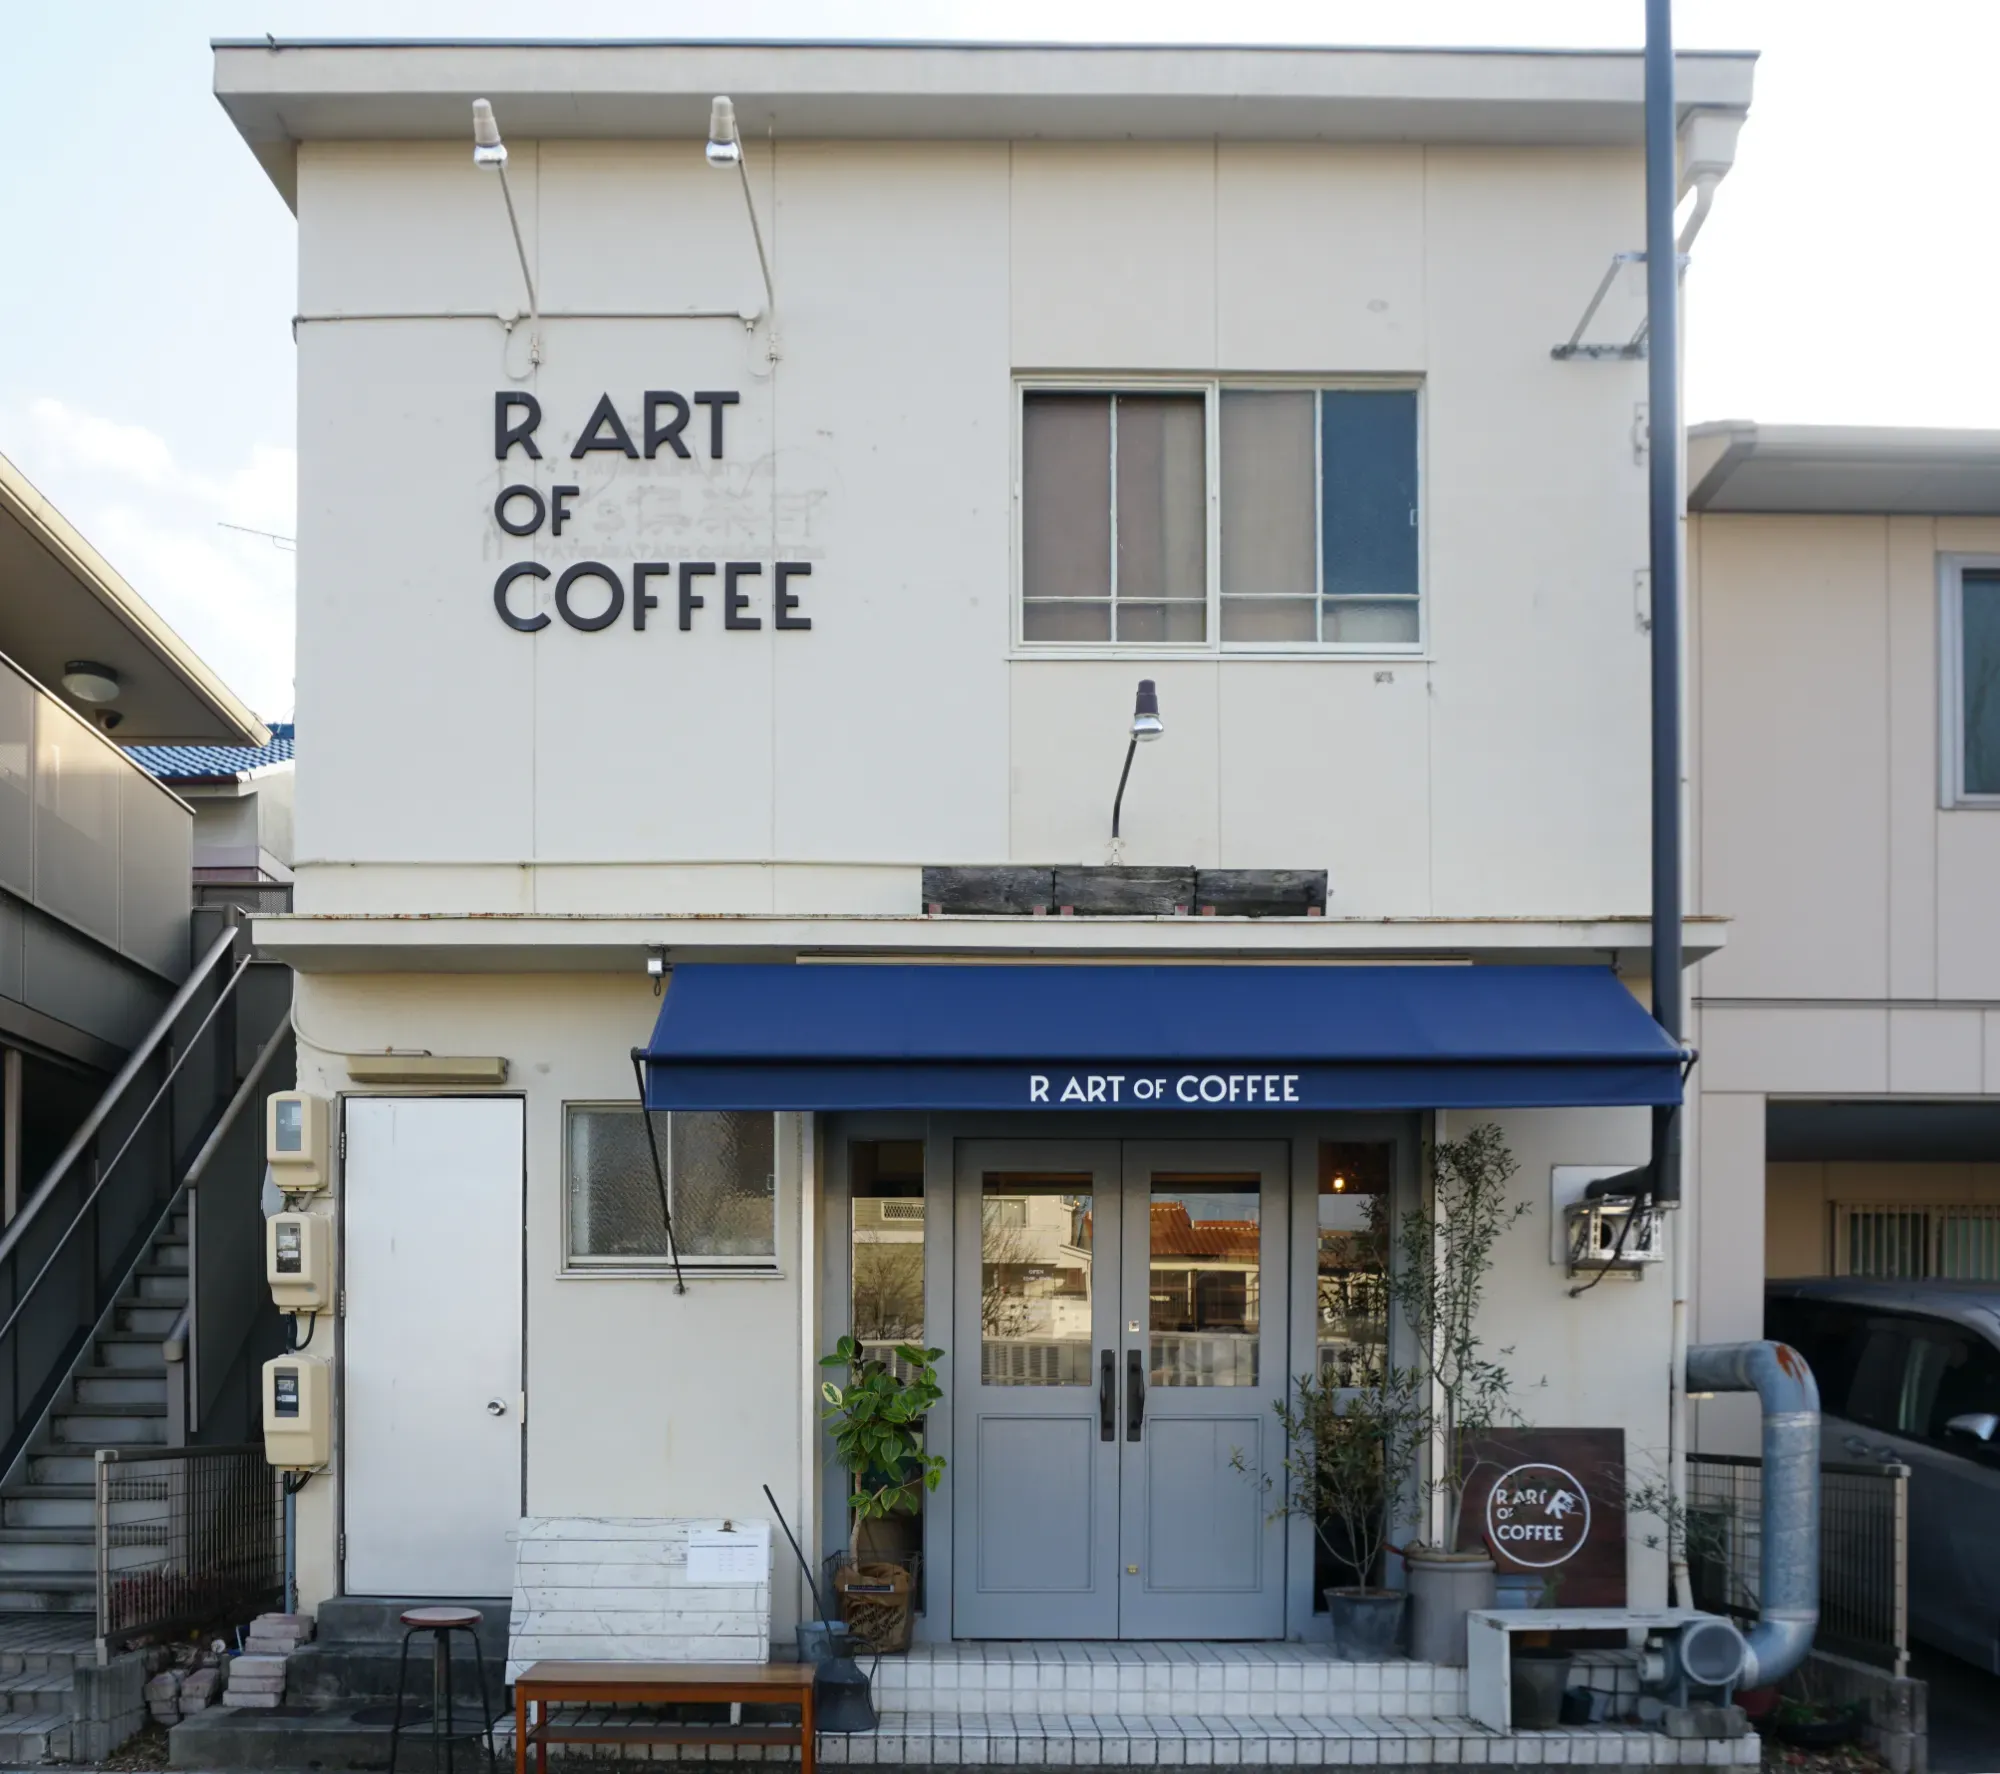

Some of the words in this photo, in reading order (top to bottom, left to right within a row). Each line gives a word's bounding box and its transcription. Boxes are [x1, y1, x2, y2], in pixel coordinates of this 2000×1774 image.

[494, 390, 543, 459] R
[570, 390, 740, 459] ART
[494, 484, 580, 536] OF
[493, 560, 812, 632] COFFEE
[1030, 1075, 1050, 1102] R
[1060, 1075, 1125, 1102] ART
[1133, 1078, 1167, 1099] OF
[1176, 1075, 1300, 1102] COFFEE
[1496, 1489, 1508, 1505] R
[1497, 1524, 1564, 1541] COFFEE
